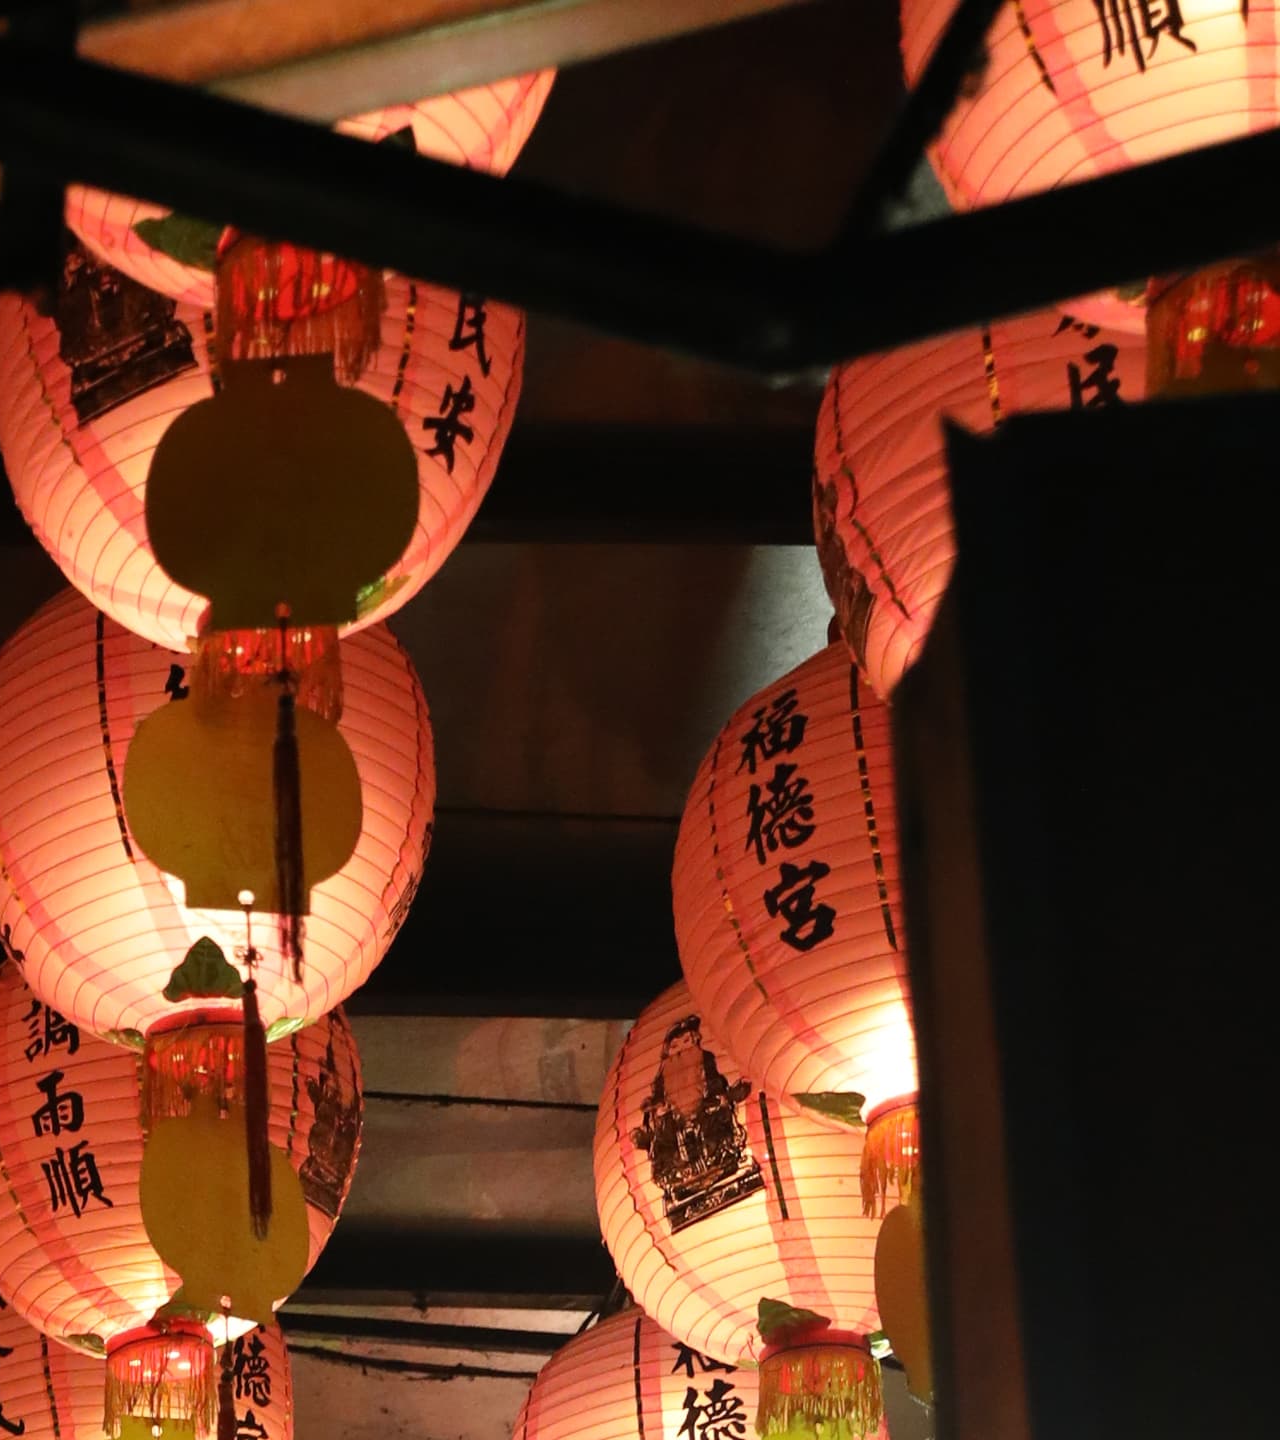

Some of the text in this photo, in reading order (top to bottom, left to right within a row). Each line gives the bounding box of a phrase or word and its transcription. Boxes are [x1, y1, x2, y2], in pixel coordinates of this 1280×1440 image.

[736, 690, 837, 951] 福德宮
[27, 998, 114, 1219] 調雨順
